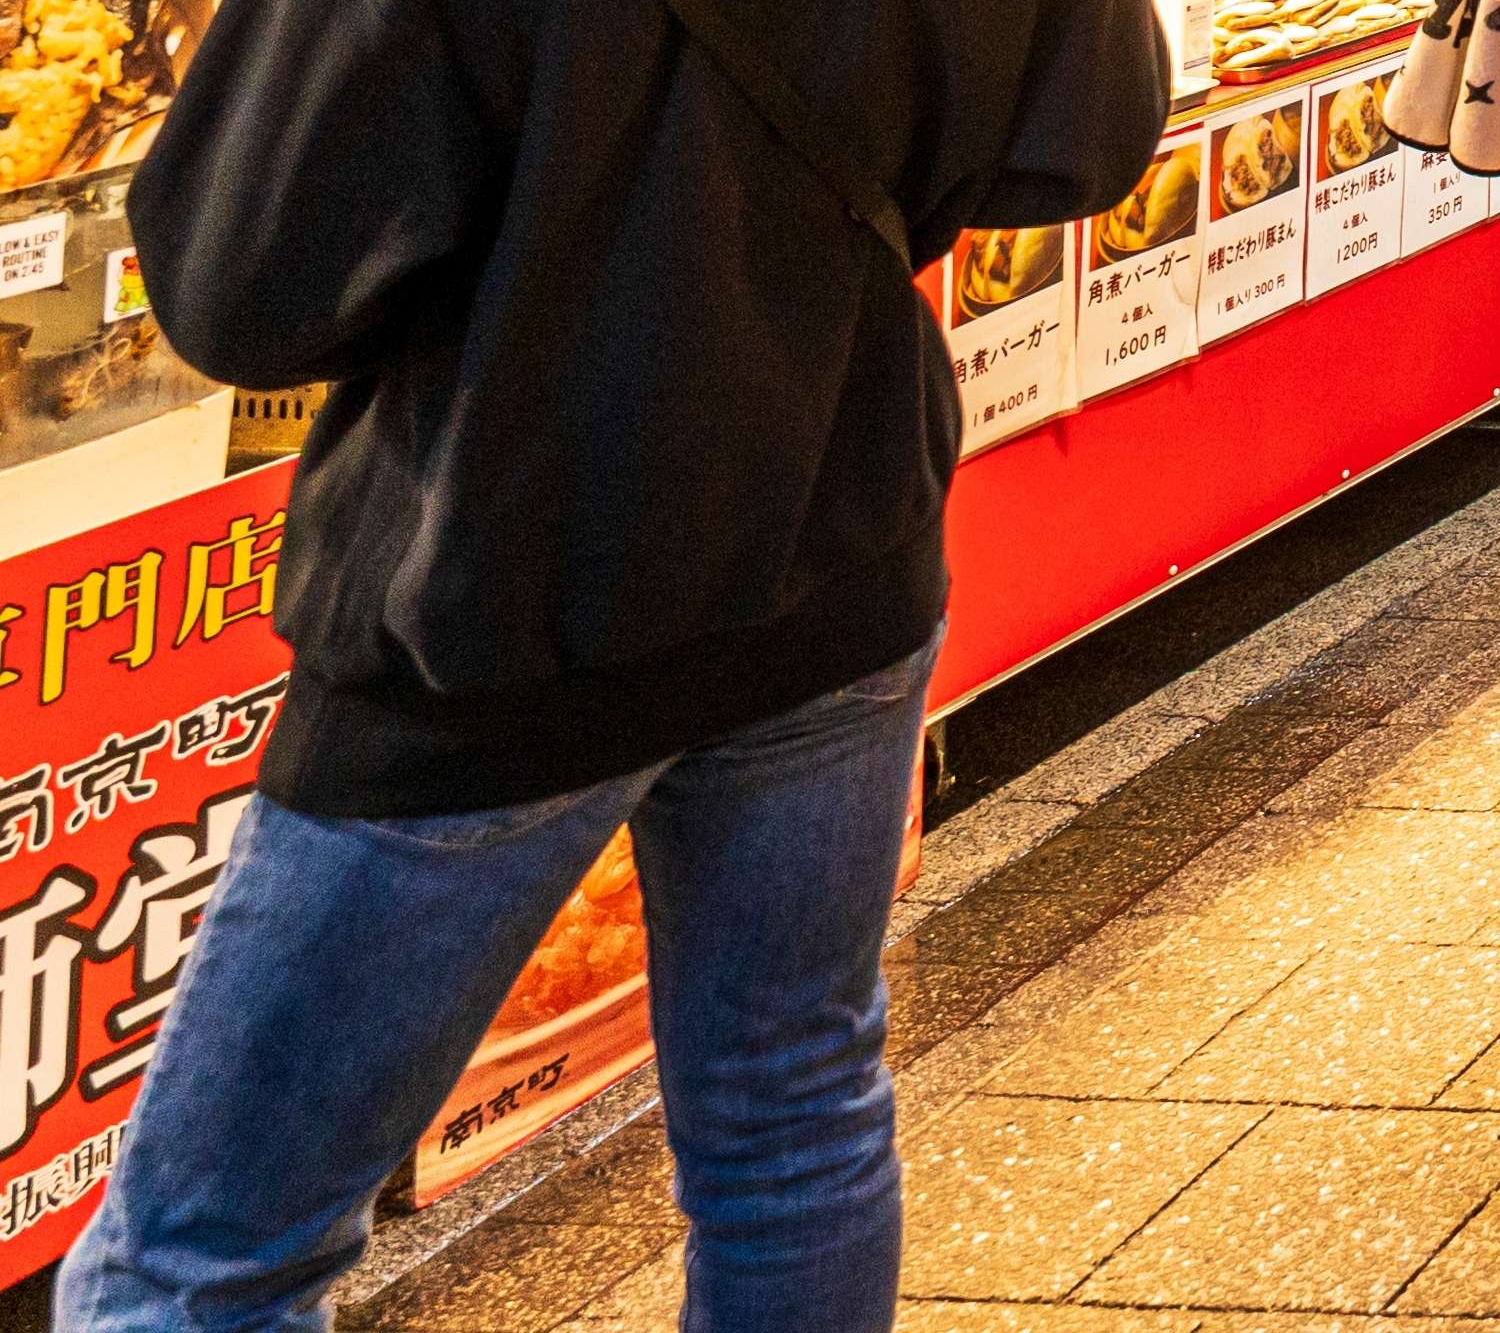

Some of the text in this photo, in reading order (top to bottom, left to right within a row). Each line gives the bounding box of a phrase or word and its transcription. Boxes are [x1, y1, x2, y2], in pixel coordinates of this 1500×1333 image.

[1313, 162, 1398, 216] 特製こだわり豚まん
[1427, 195, 1463, 225] 350円
[1341, 210, 1370, 232] 4個入
[1206, 221, 1297, 278] 特製こだわり豚まん
[1335, 230, 1379, 266] 1200円
[1086, 248, 1192, 308] 角煮バーガー
[1119, 301, 1155, 326] 4個入
[953, 318, 1061, 385] 角煮バーガー
[1103, 325, 1168, 368] 1,600円
[973, 383, 1040, 429] 1個400円
[0, 508, 287, 705] 門店
